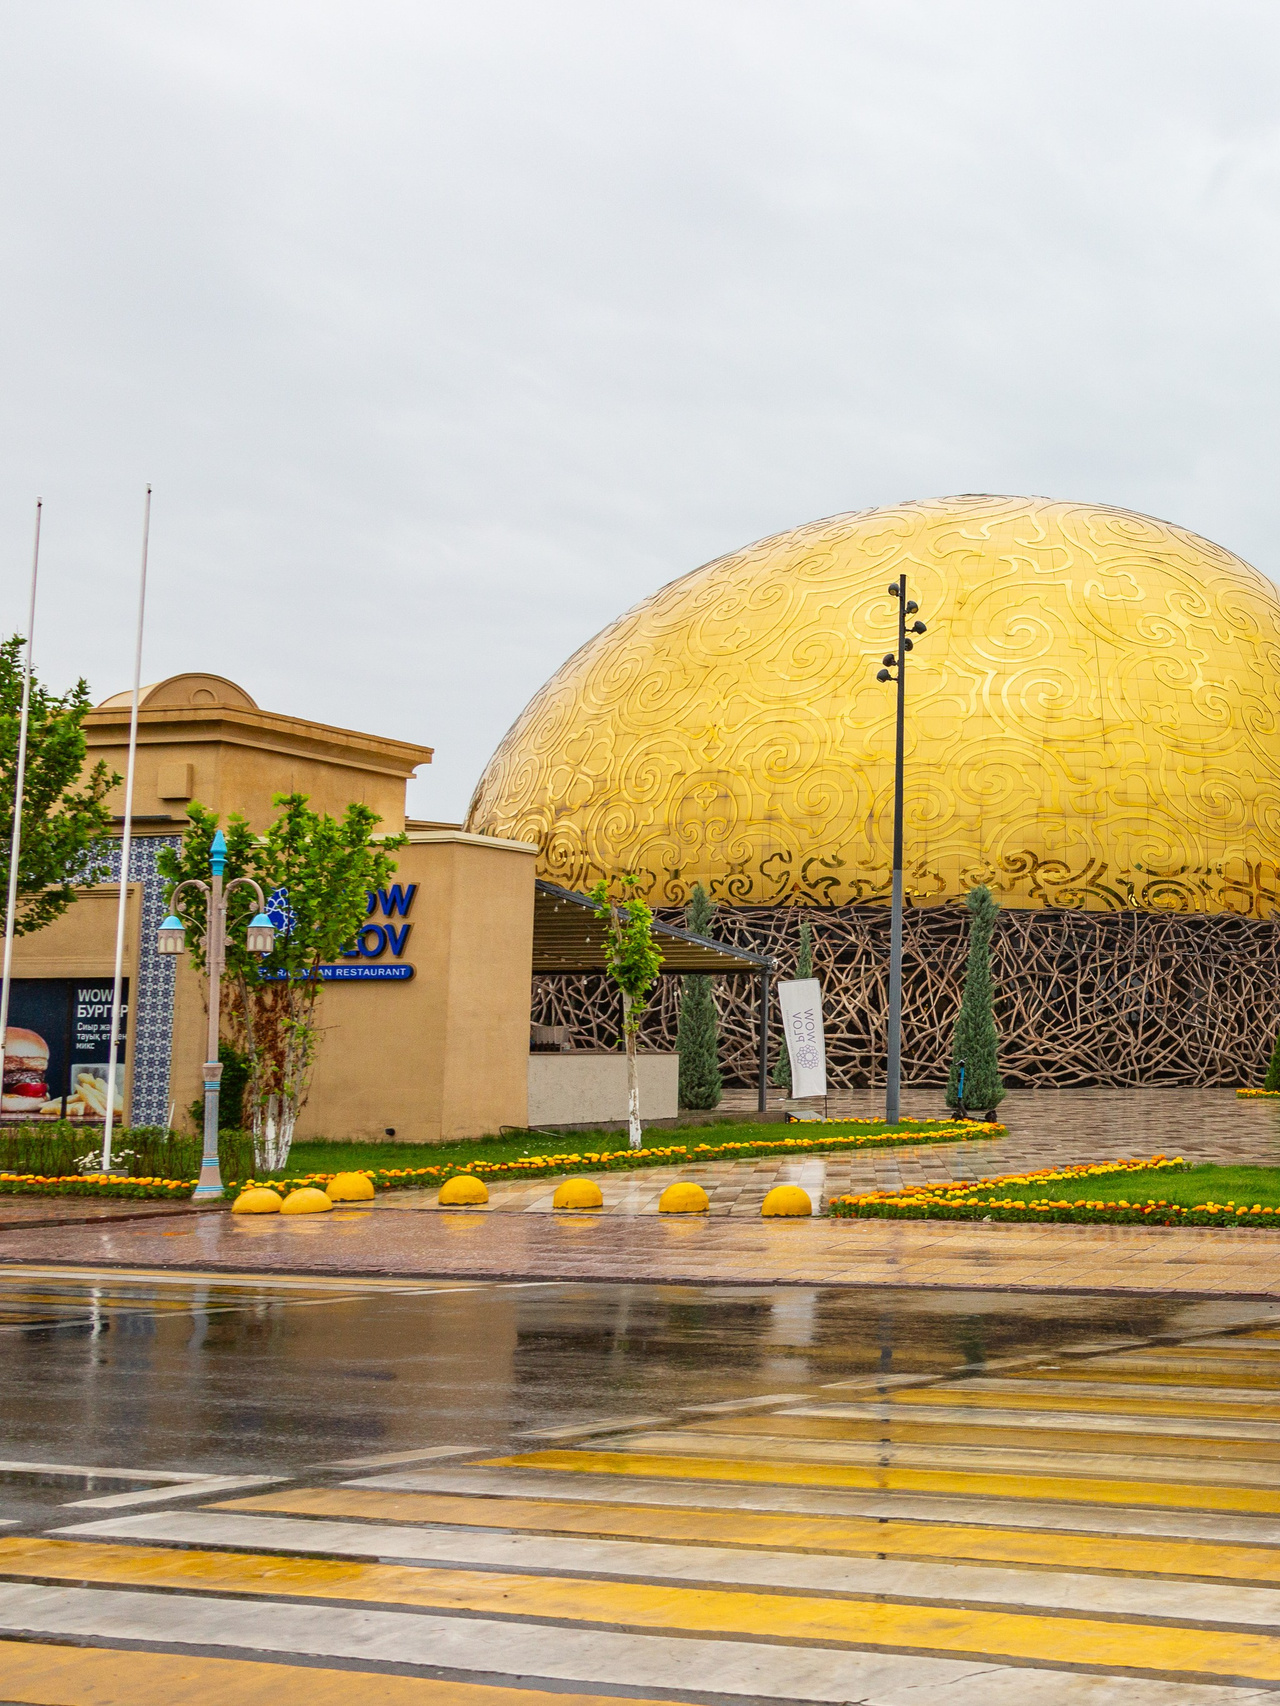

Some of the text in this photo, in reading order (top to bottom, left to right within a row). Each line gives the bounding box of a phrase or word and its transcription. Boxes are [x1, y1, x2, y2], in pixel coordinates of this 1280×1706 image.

[336, 968, 406, 976] RESTAURANT
[78, 988, 114, 1002] WOW
[77, 1004, 128, 1018] БУРГР
